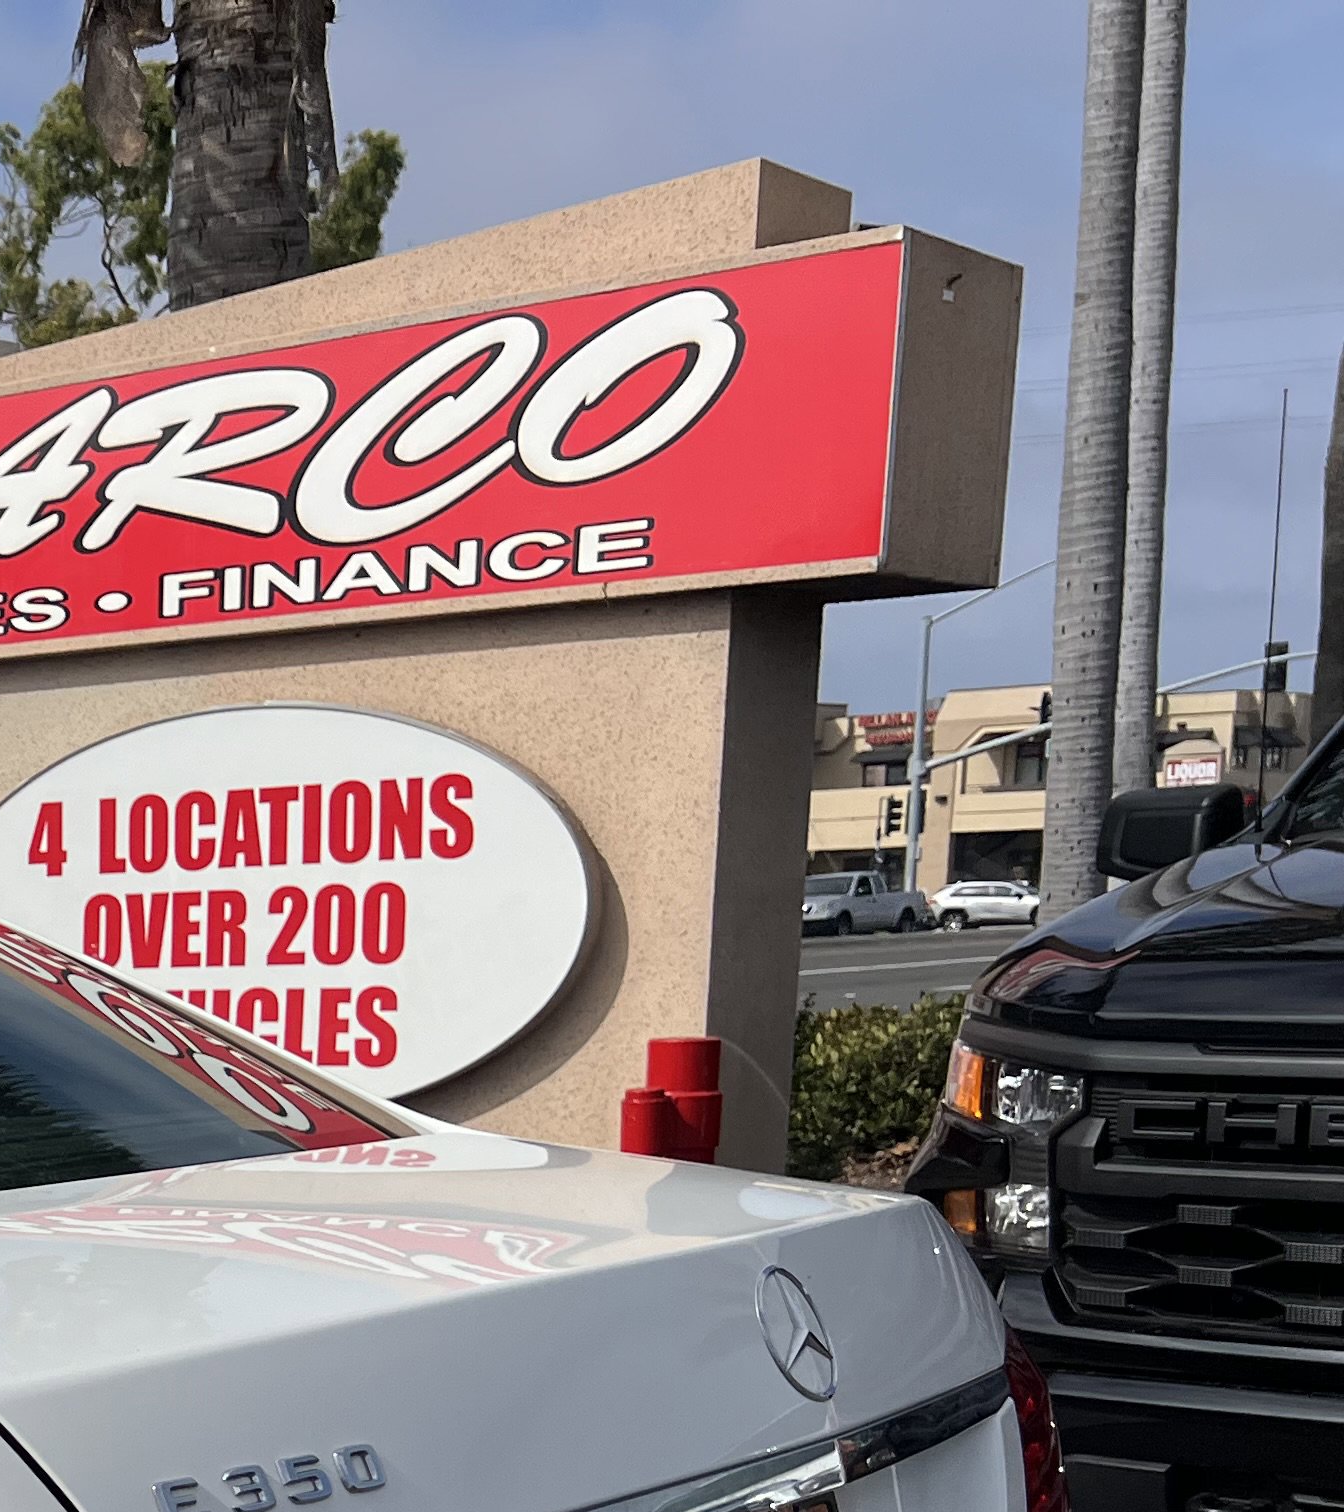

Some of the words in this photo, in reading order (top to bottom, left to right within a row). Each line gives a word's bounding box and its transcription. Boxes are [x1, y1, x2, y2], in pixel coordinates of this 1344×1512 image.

[159, 518, 654, 617] FINANCE
[28, 801, 67, 876] 4
[99, 773, 474, 874] LOCATIONS
[83, 889, 247, 968] OVER
[267, 881, 406, 966] 200
[165, 986, 398, 1067] CLES
